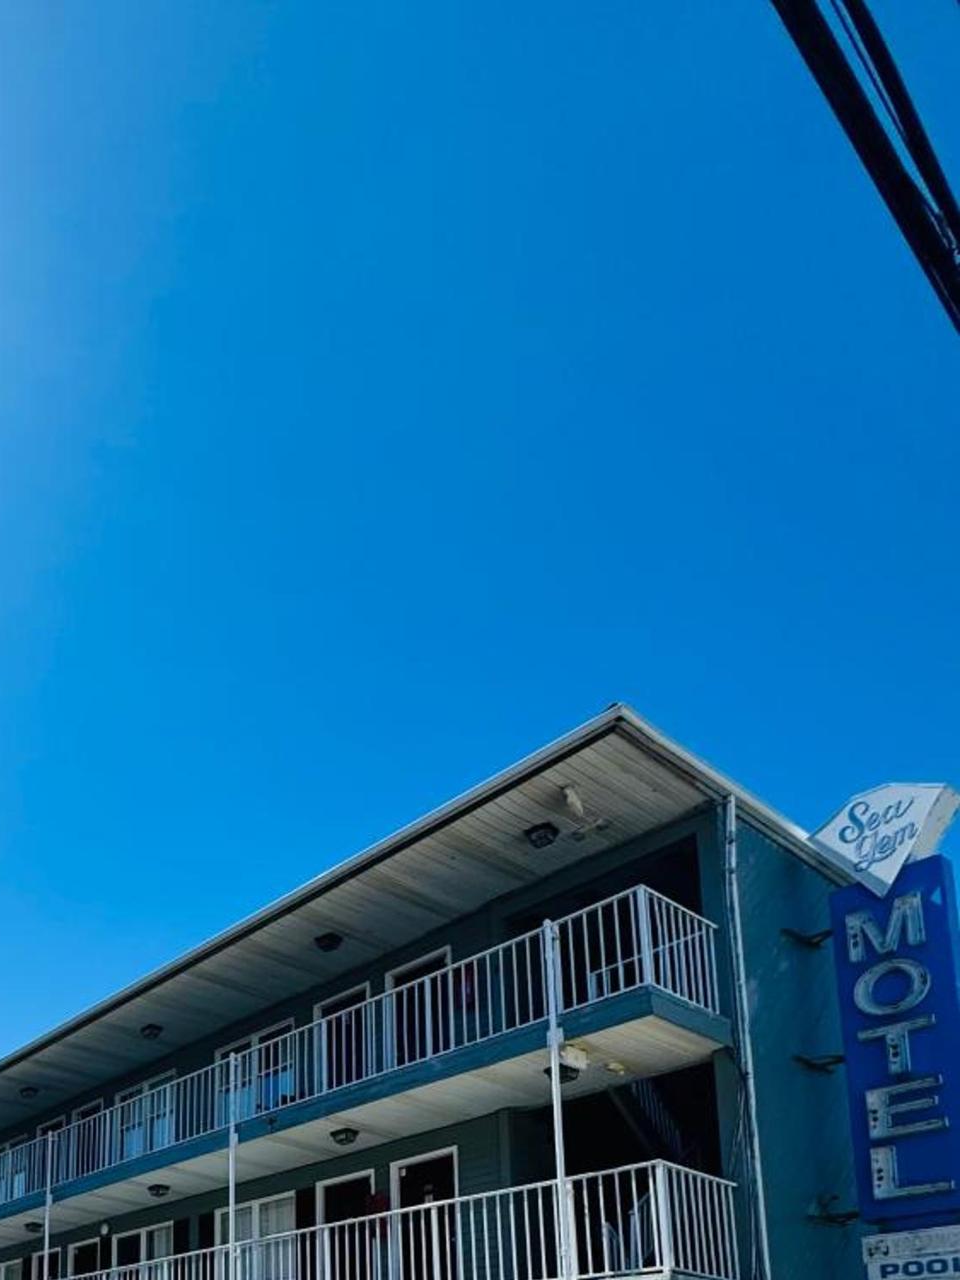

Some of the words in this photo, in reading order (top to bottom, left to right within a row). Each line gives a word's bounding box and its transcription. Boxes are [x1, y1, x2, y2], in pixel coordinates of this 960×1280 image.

[838, 796, 915, 844] Sea
[854, 821, 920, 873] Gem
[844, 890, 955, 1201] MOTEL
